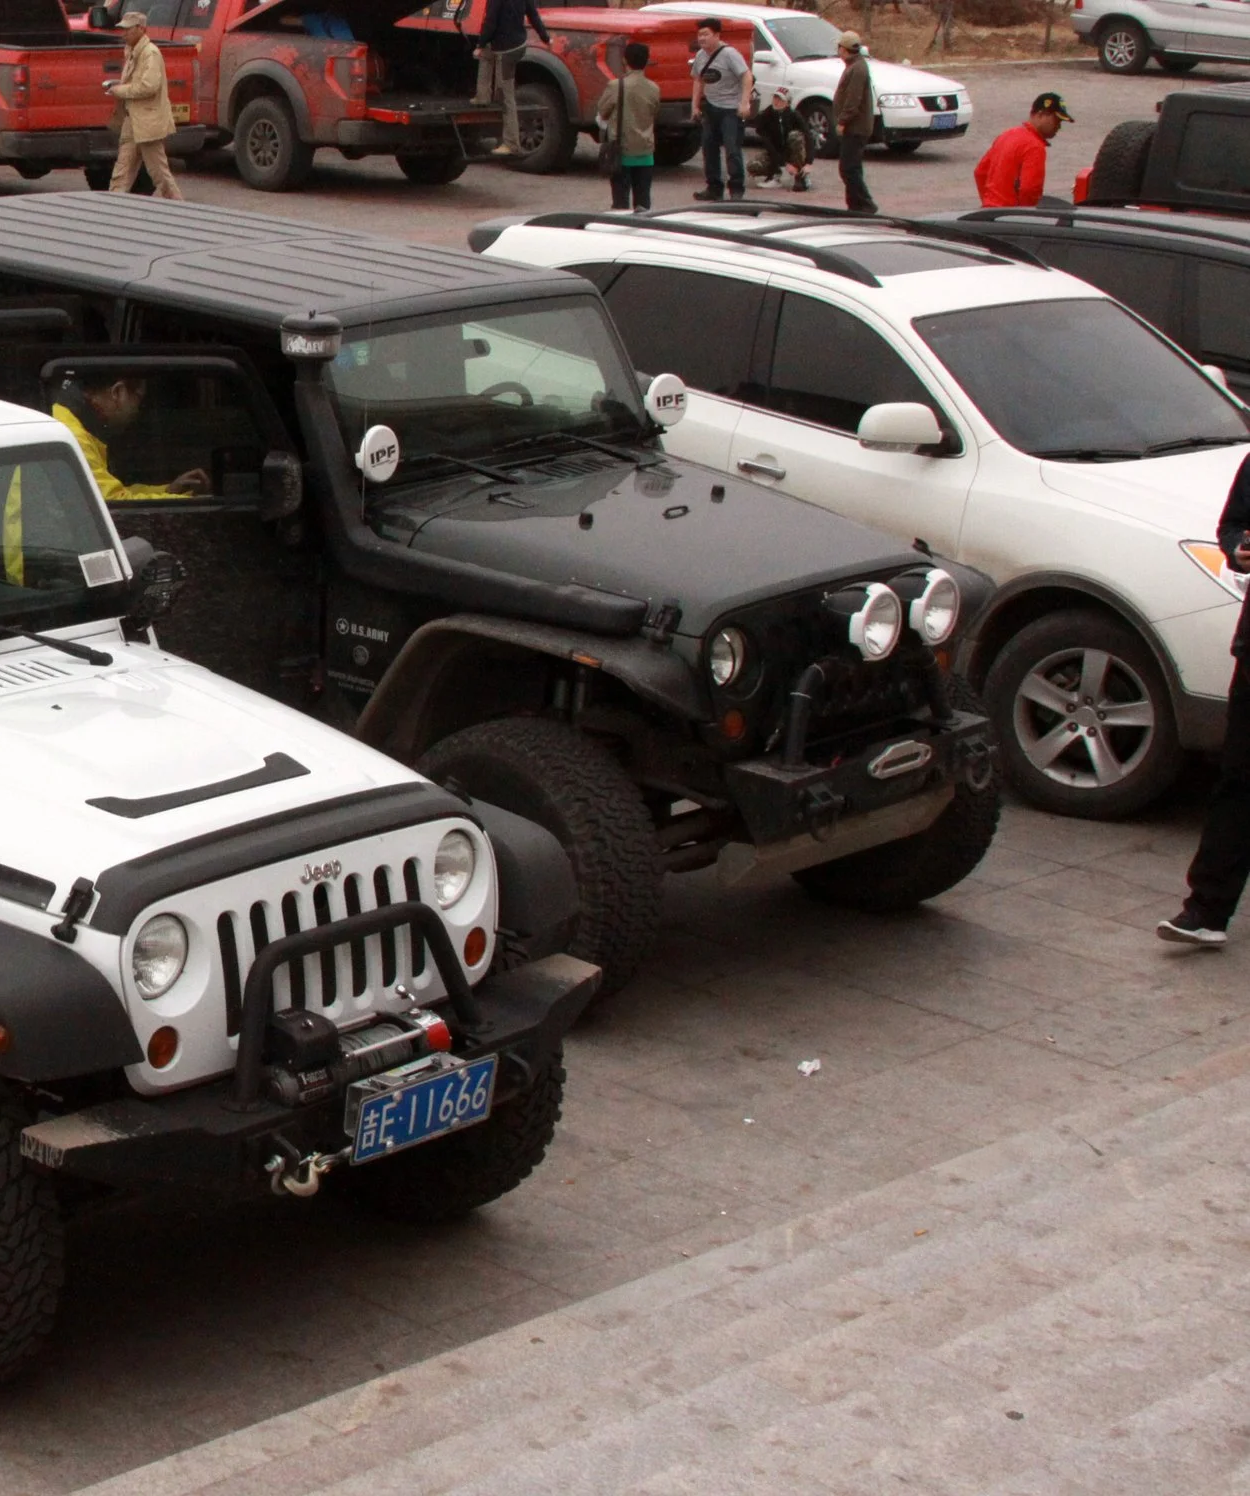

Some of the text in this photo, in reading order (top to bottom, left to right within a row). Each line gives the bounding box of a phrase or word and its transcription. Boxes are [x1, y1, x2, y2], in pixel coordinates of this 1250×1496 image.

[656, 393, 684, 407] IPF
[370, 444, 396, 465] IPF
[300, 859, 342, 885] Jeep
